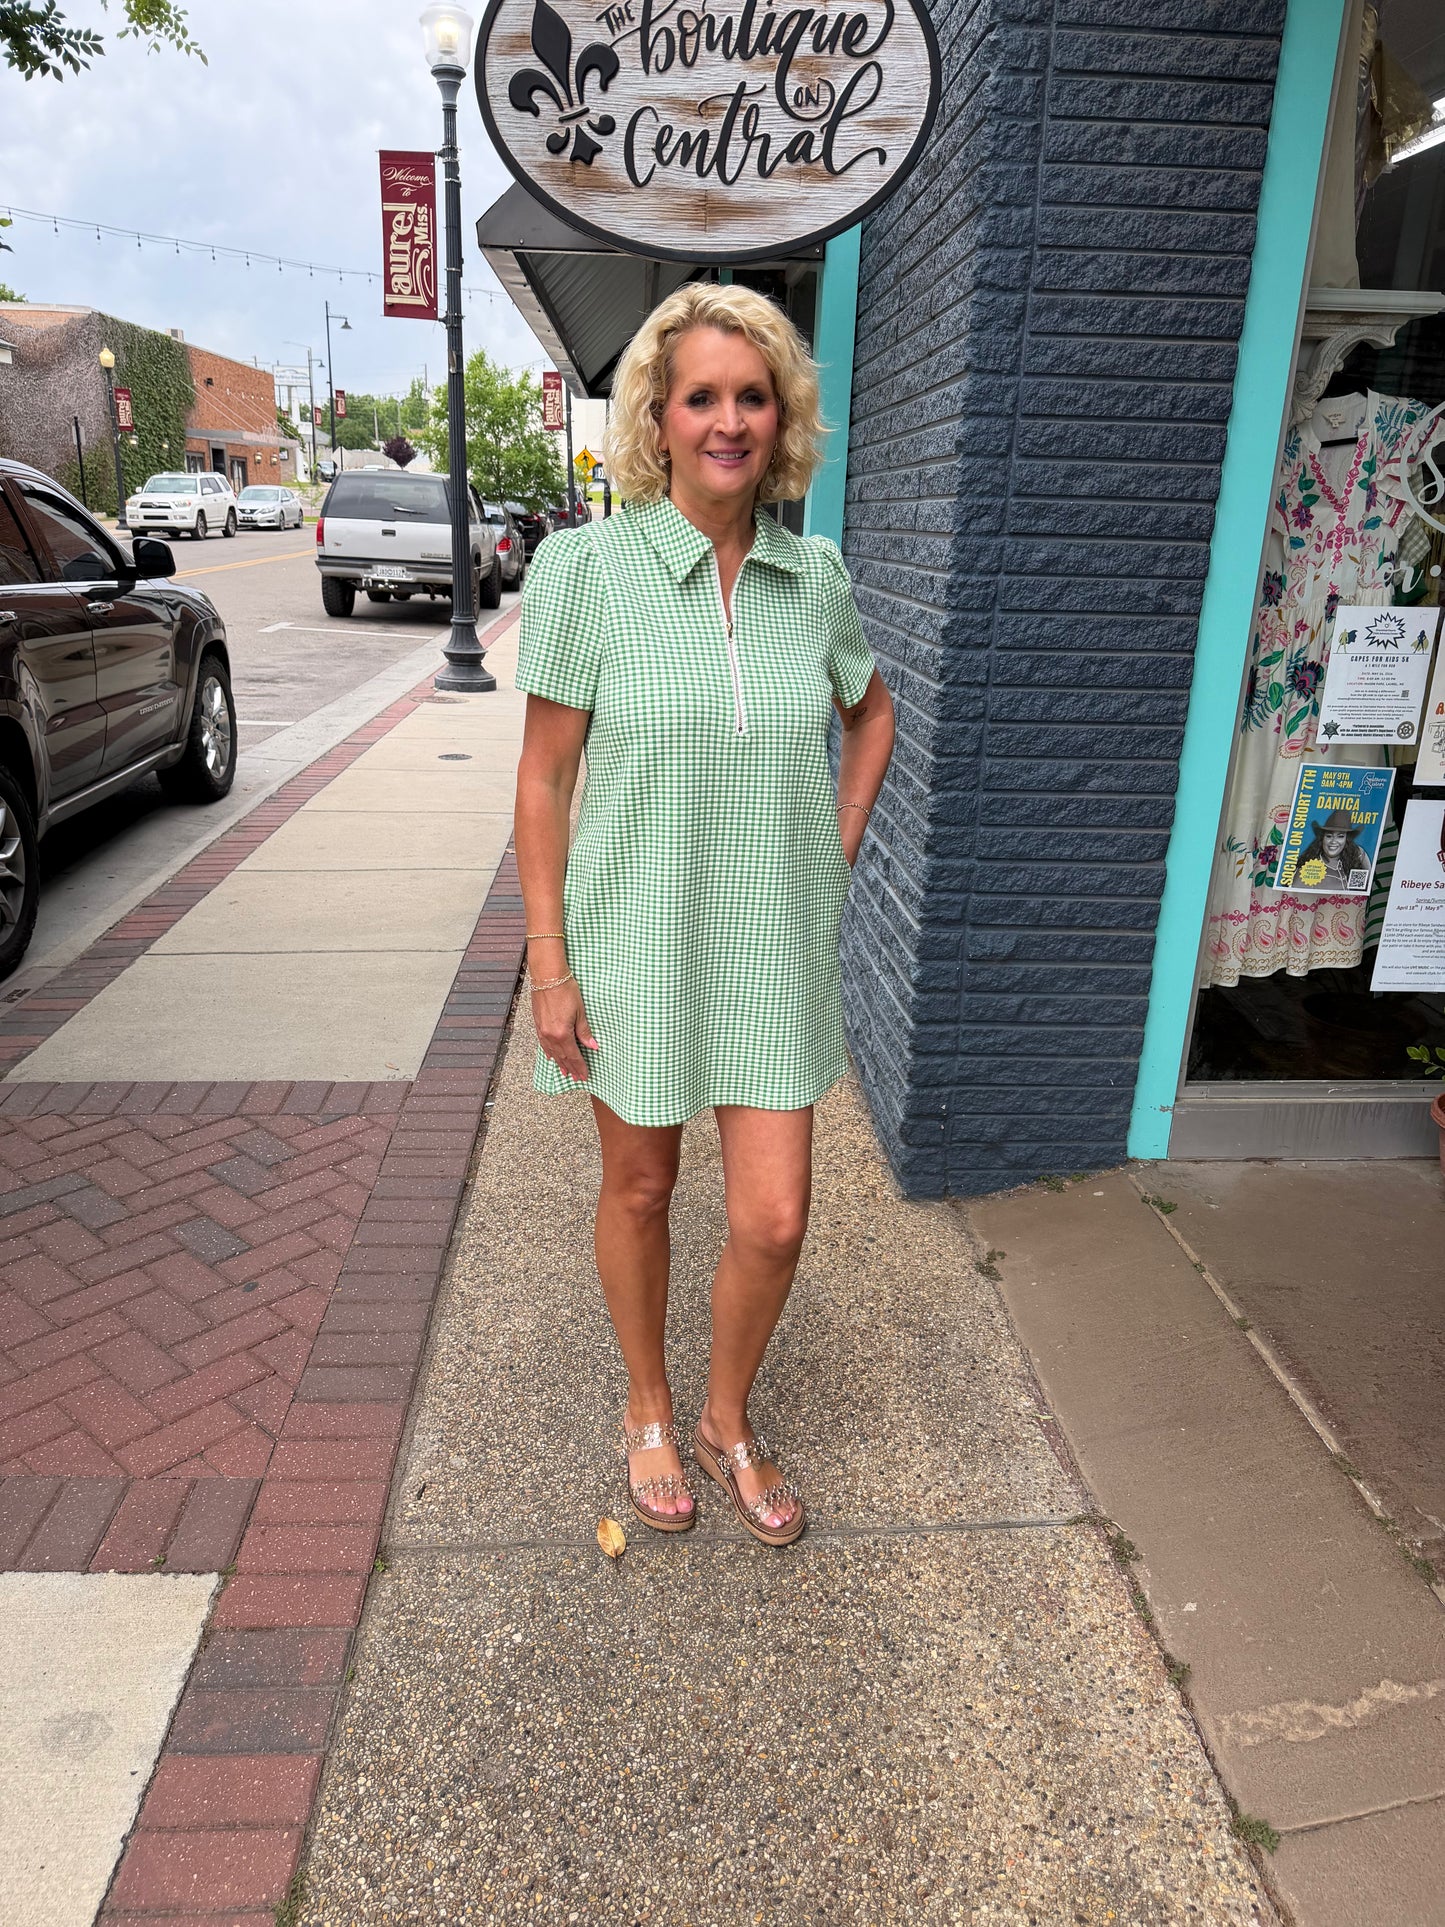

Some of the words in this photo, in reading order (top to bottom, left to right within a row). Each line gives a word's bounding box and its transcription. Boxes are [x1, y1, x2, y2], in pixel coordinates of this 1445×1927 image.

[597, 1, 636, 35] THE
[793, 84, 821, 108] ON
[624, 61, 886, 187] Central
[383, 166, 433, 186] Welcome
[400, 187, 417, 197] to
[414, 203, 429, 249] Miss.
[1301, 769, 1317, 790] 7TH
[1320, 780, 1335, 788] 9AM
[1323, 771, 1337, 780] MAY
[1336, 772, 1350, 781] 9TH
[1293, 792, 1312, 829] SHORT
[1316, 796, 1361, 811] DANICA
[1350, 811, 1379, 825] HART
[1289, 831, 1304, 846] ON
[1280, 848, 1300, 887] SOCIAL
[1400, 880, 1433, 891] Ribeye
